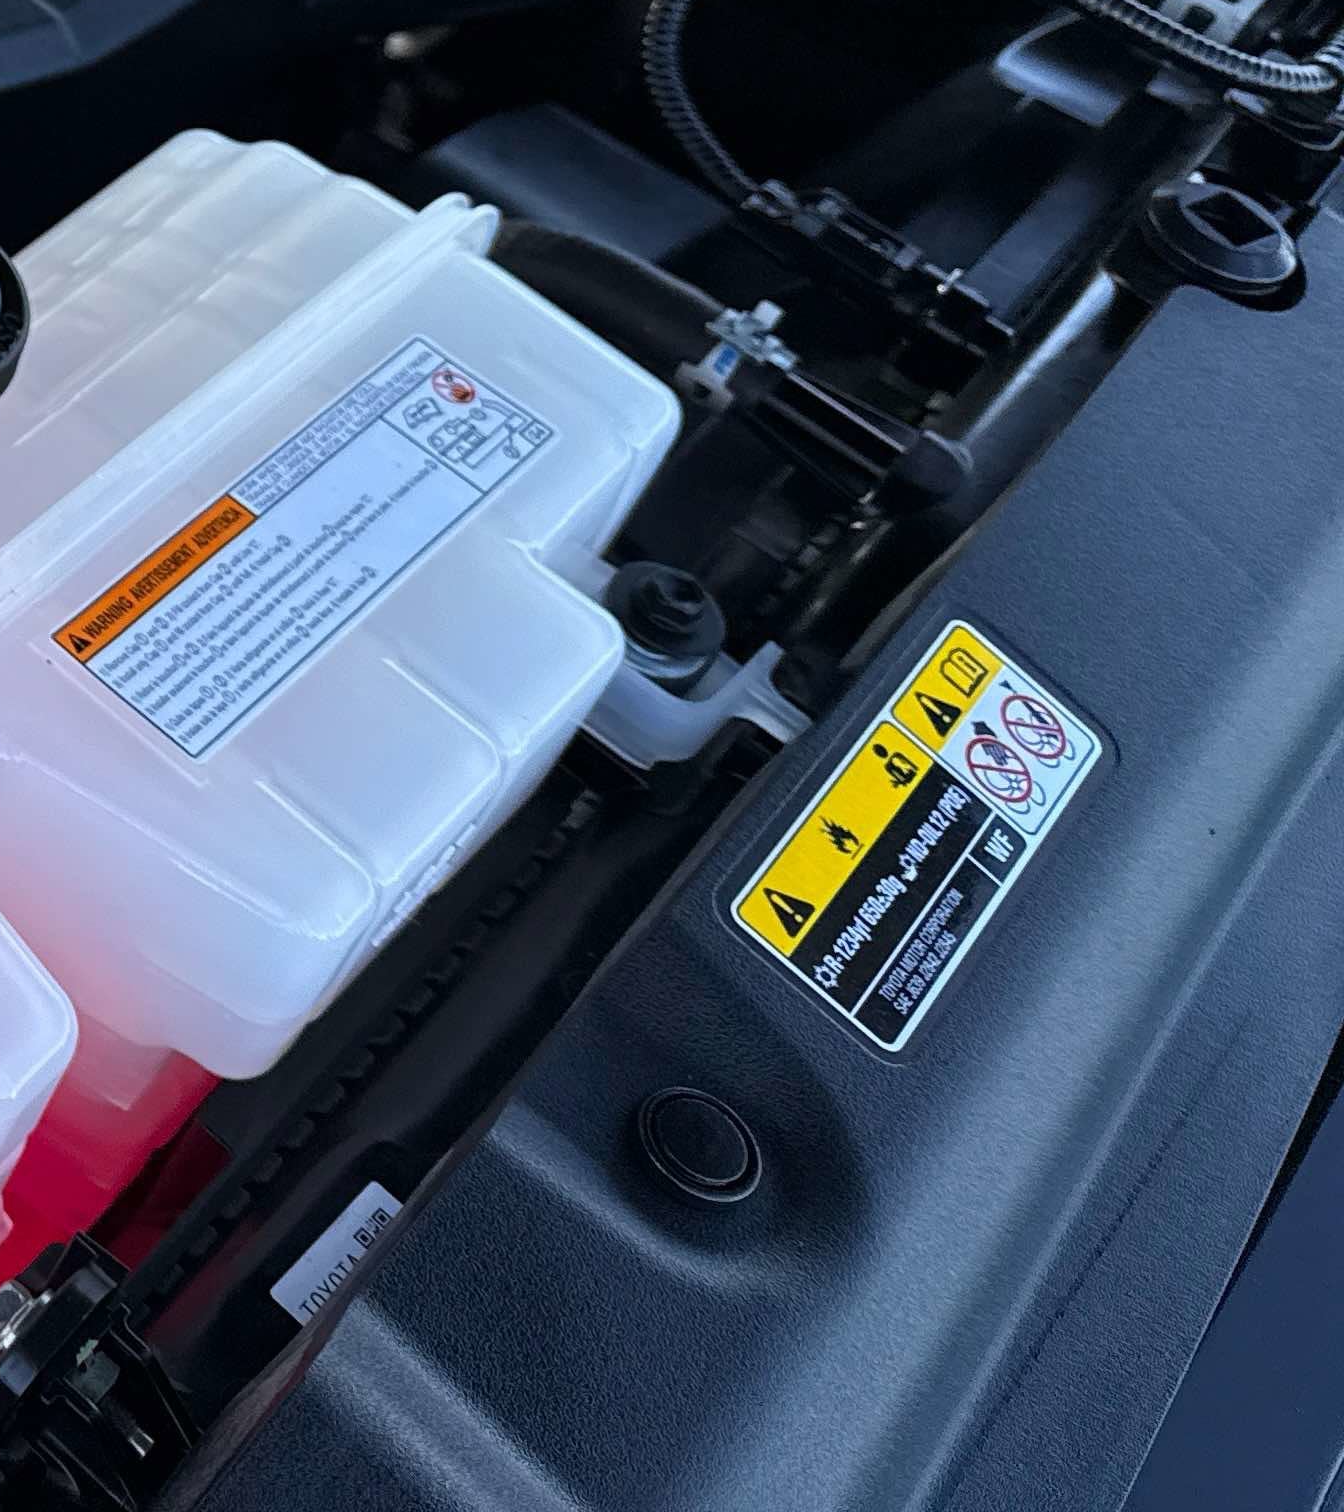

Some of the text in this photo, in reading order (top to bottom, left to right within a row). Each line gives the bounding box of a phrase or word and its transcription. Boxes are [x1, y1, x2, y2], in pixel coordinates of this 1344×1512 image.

[82, 596, 134, 639] WARNING
[128, 543, 196, 601] AVERTISSEMENT
[983, 827, 1016, 864] WF
[878, 887, 964, 1003] TOYOTA MOTOR CORPORATION
[892, 992, 914, 1016] SAE
[298, 1254, 360, 1316] TOYOTA
